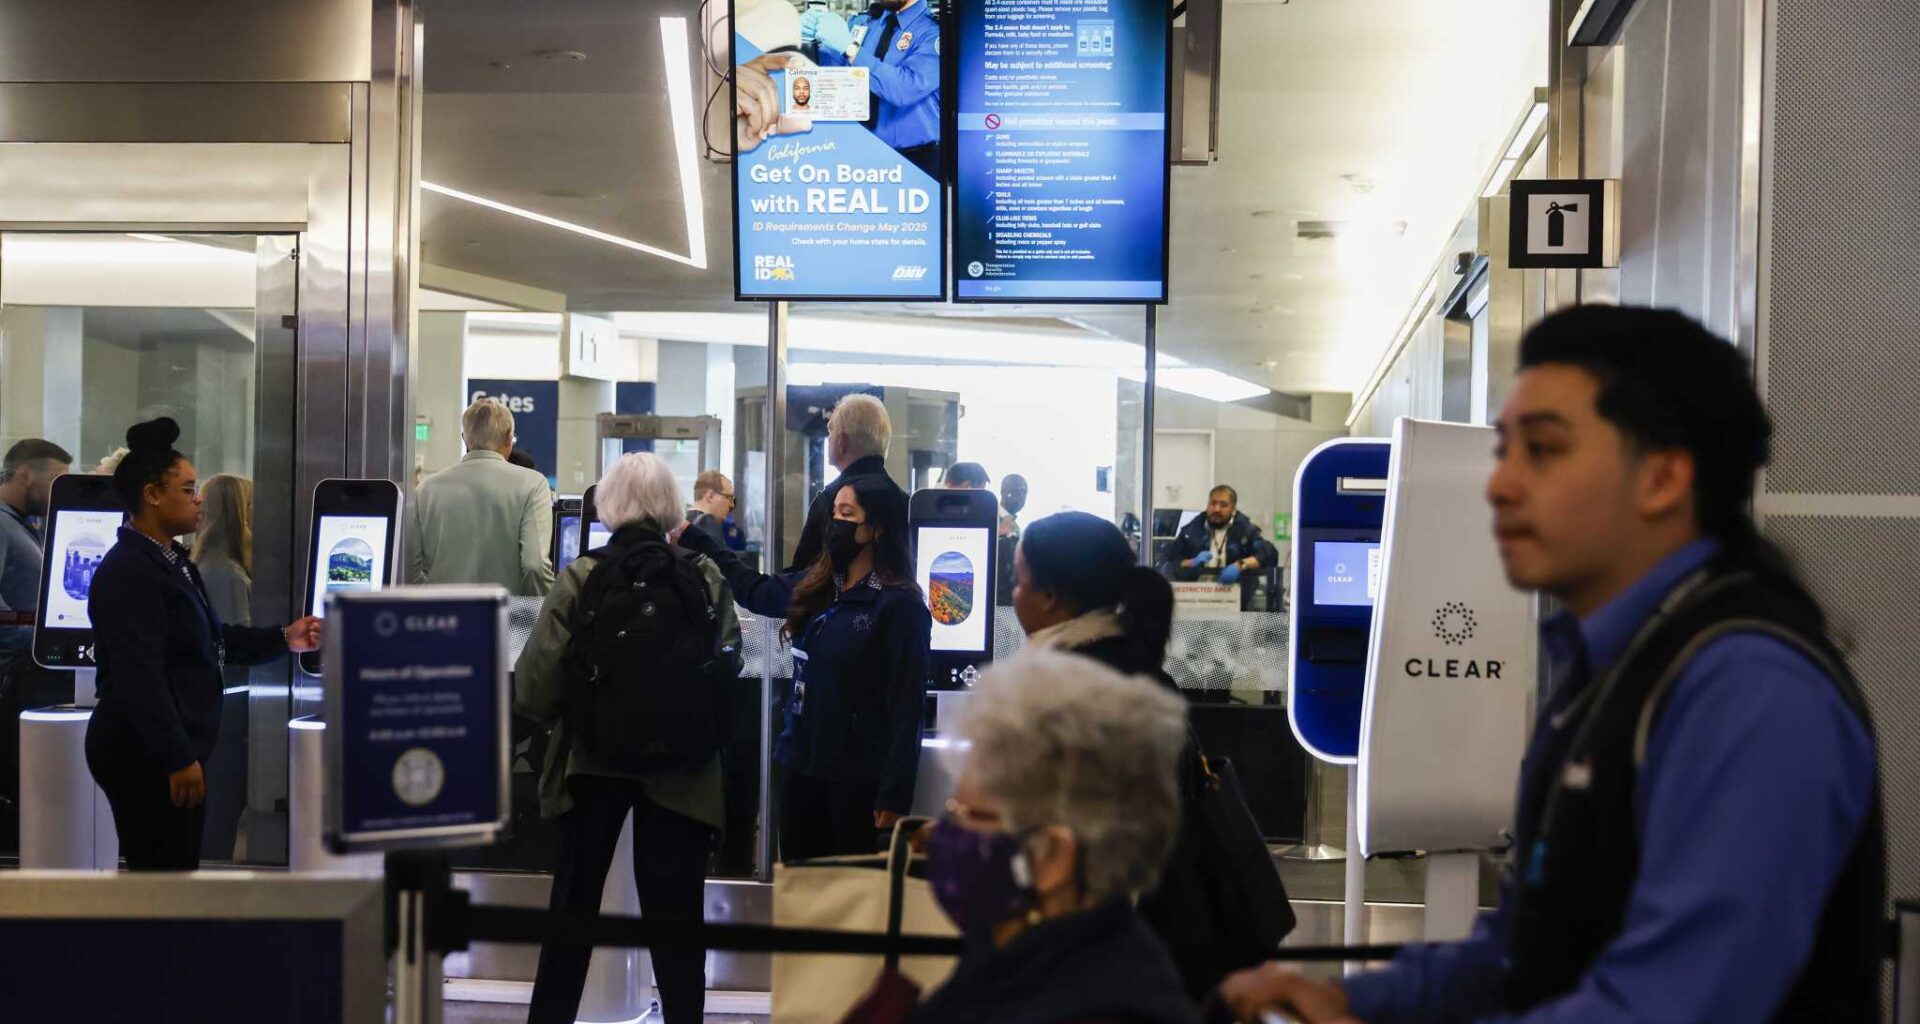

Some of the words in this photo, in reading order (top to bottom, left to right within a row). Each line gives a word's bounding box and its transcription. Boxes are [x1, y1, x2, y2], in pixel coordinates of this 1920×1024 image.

[984, 61, 998, 71] May
[1000, 61, 1008, 71] be
[1010, 61, 1034, 71] subject
[1035, 61, 1043, 71] to
[1044, 61, 1077, 71] additional
[768, 138, 836, 164] California
[750, 164, 792, 184] Get
[798, 164, 830, 184] On
[837, 164, 902, 184] Board
[751, 194, 800, 213] with
[806, 188, 888, 214] REAL
[898, 188, 930, 214] ID
[752, 222, 763, 232] ID
[766, 222, 834, 234] Requirements
[836, 222, 875, 234] Change
[878, 222, 900, 233] May
[901, 222, 928, 232] 2025
[833, 238, 848, 246] your
[754, 255, 795, 268] REAL
[754, 268, 771, 280] ID
[892, 266, 928, 278] DMV
[404, 614, 459, 632] CLEAR
[1405, 658, 1501, 679] CLEAR
